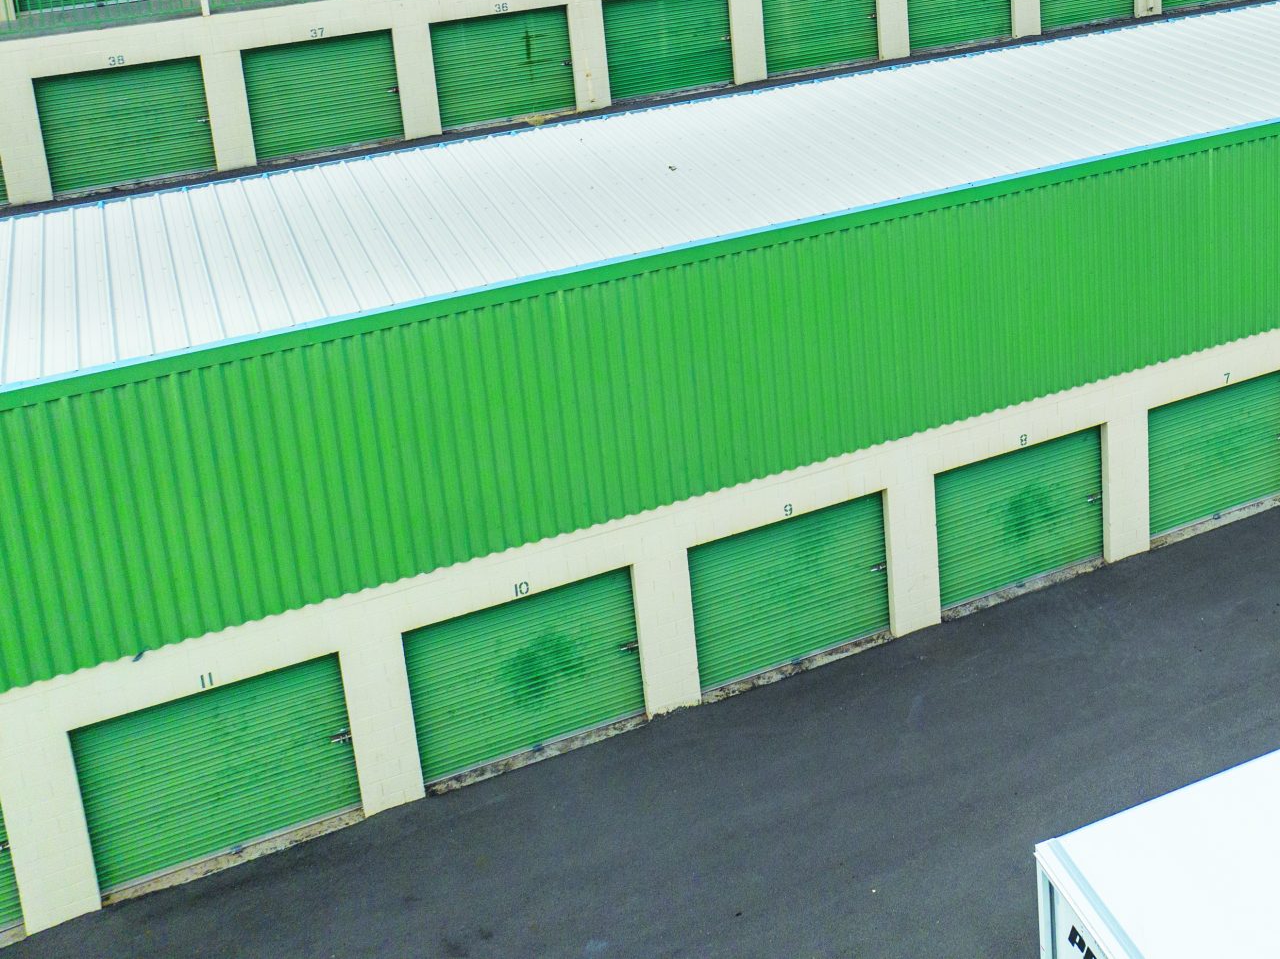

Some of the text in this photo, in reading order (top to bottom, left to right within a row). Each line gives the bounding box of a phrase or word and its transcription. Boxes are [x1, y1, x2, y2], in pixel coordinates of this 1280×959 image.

[494, 2, 509, 12] 36
[309, 27, 324, 38] 37
[108, 55, 125, 66] 38
[1223, 372, 1231, 384] 7
[1020, 434, 1028, 446] 8
[784, 503, 793, 516] 9
[514, 581, 529, 597] 10
[200, 672, 213, 689] 11
